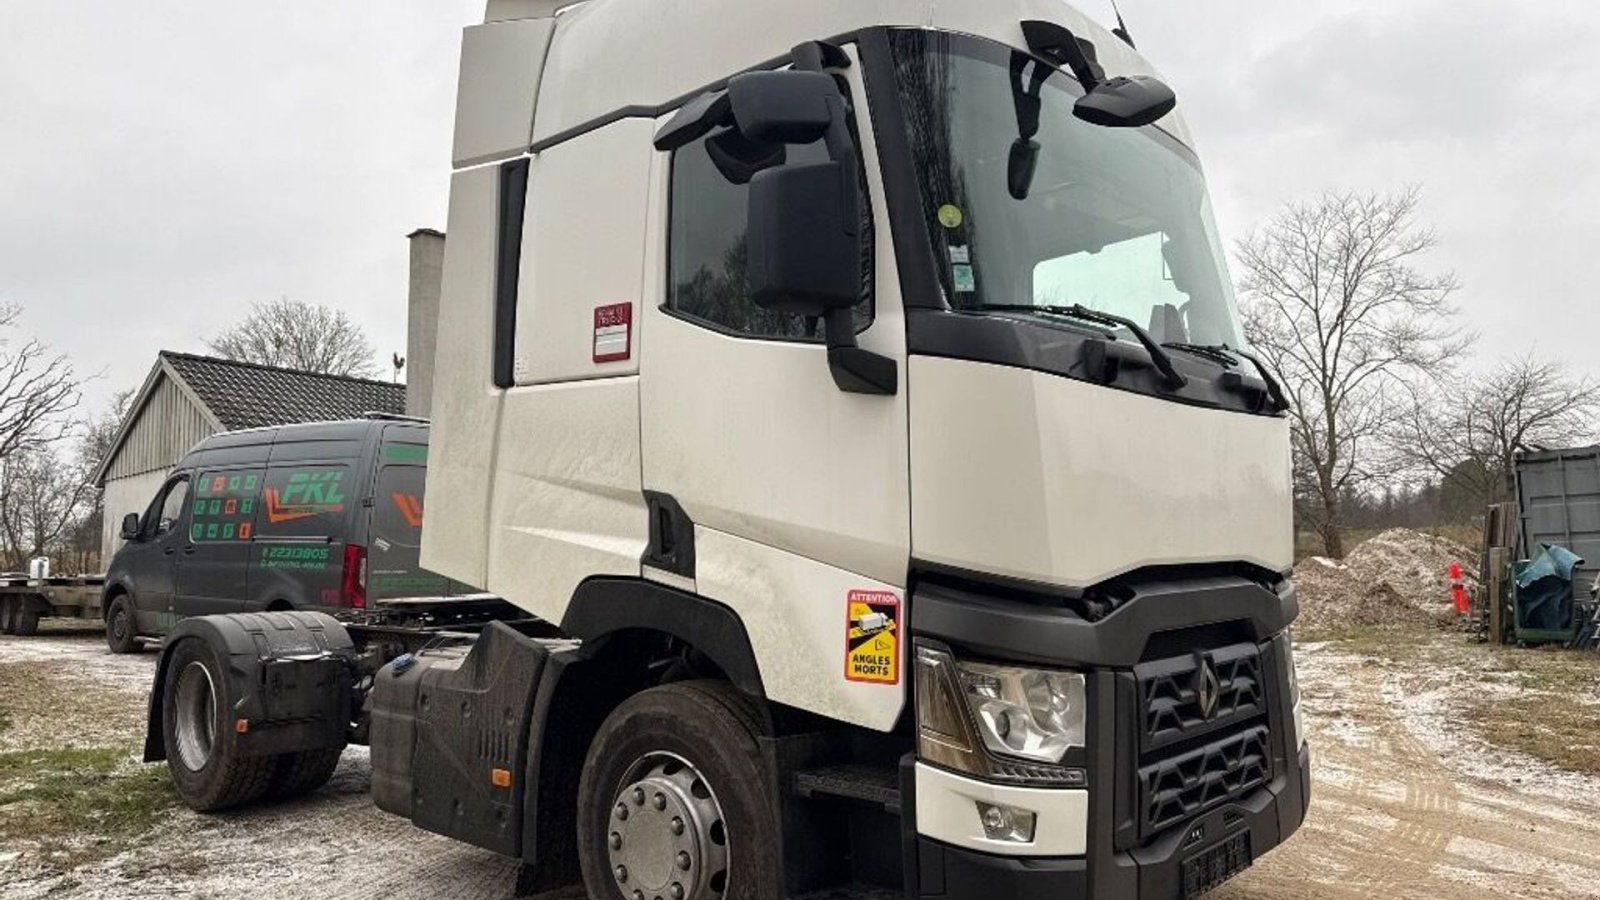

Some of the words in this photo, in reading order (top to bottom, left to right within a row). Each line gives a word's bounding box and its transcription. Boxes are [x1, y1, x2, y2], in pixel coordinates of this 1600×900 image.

[281, 471, 345, 504] PKL
[850, 593, 898, 603] ATTENTION
[853, 655, 890, 665] ANGLES
[854, 664, 889, 675] MORTS
